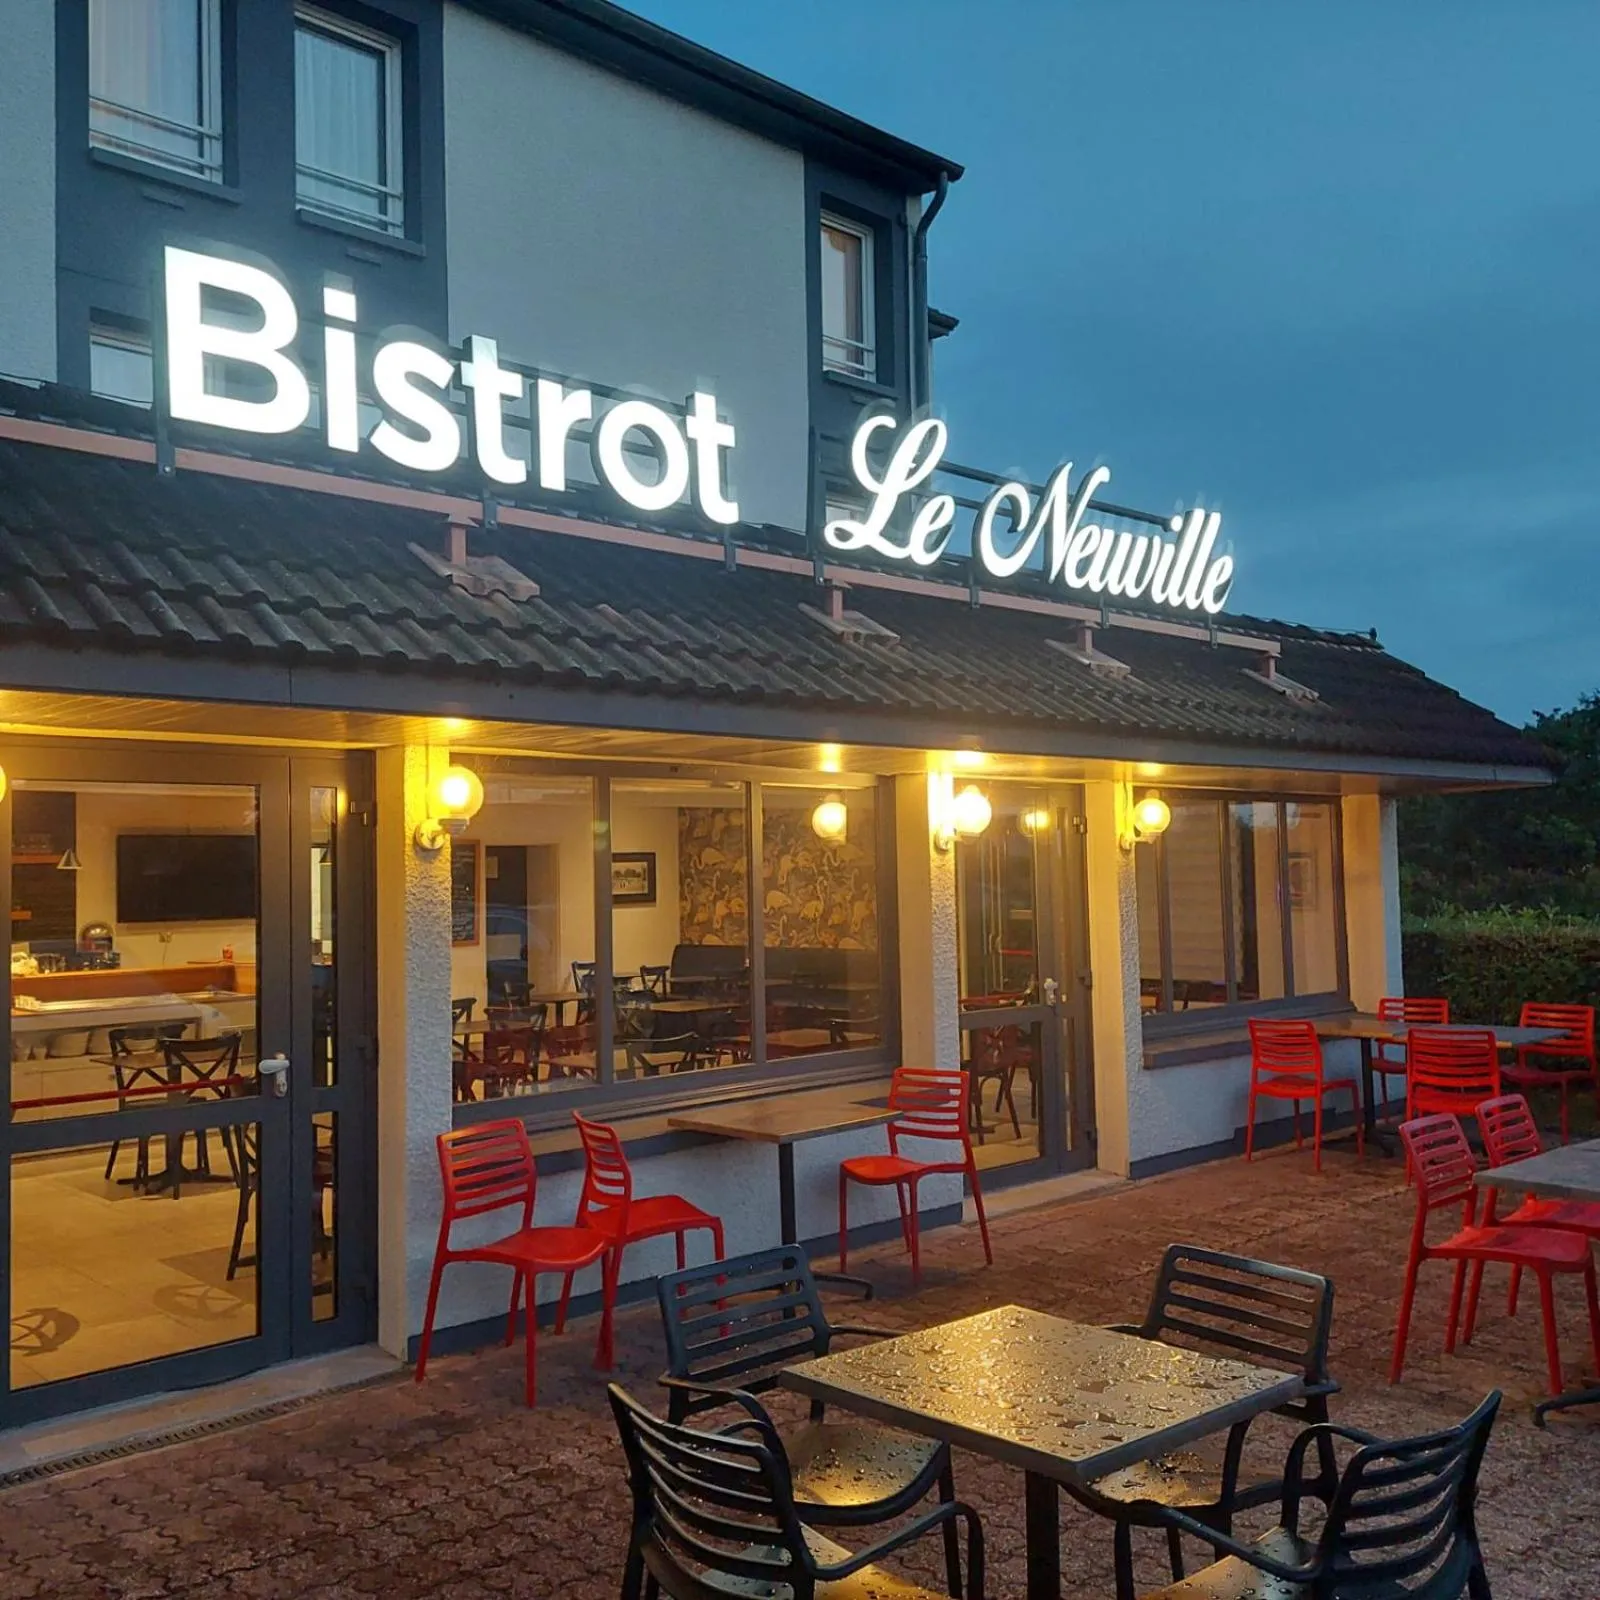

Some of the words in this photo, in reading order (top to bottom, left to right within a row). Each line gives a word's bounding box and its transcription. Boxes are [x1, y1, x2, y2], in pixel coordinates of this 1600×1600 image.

[164, 246, 739, 525] Bistrot
[824, 416, 956, 566] Le
[979, 462, 1234, 614] Neuville
